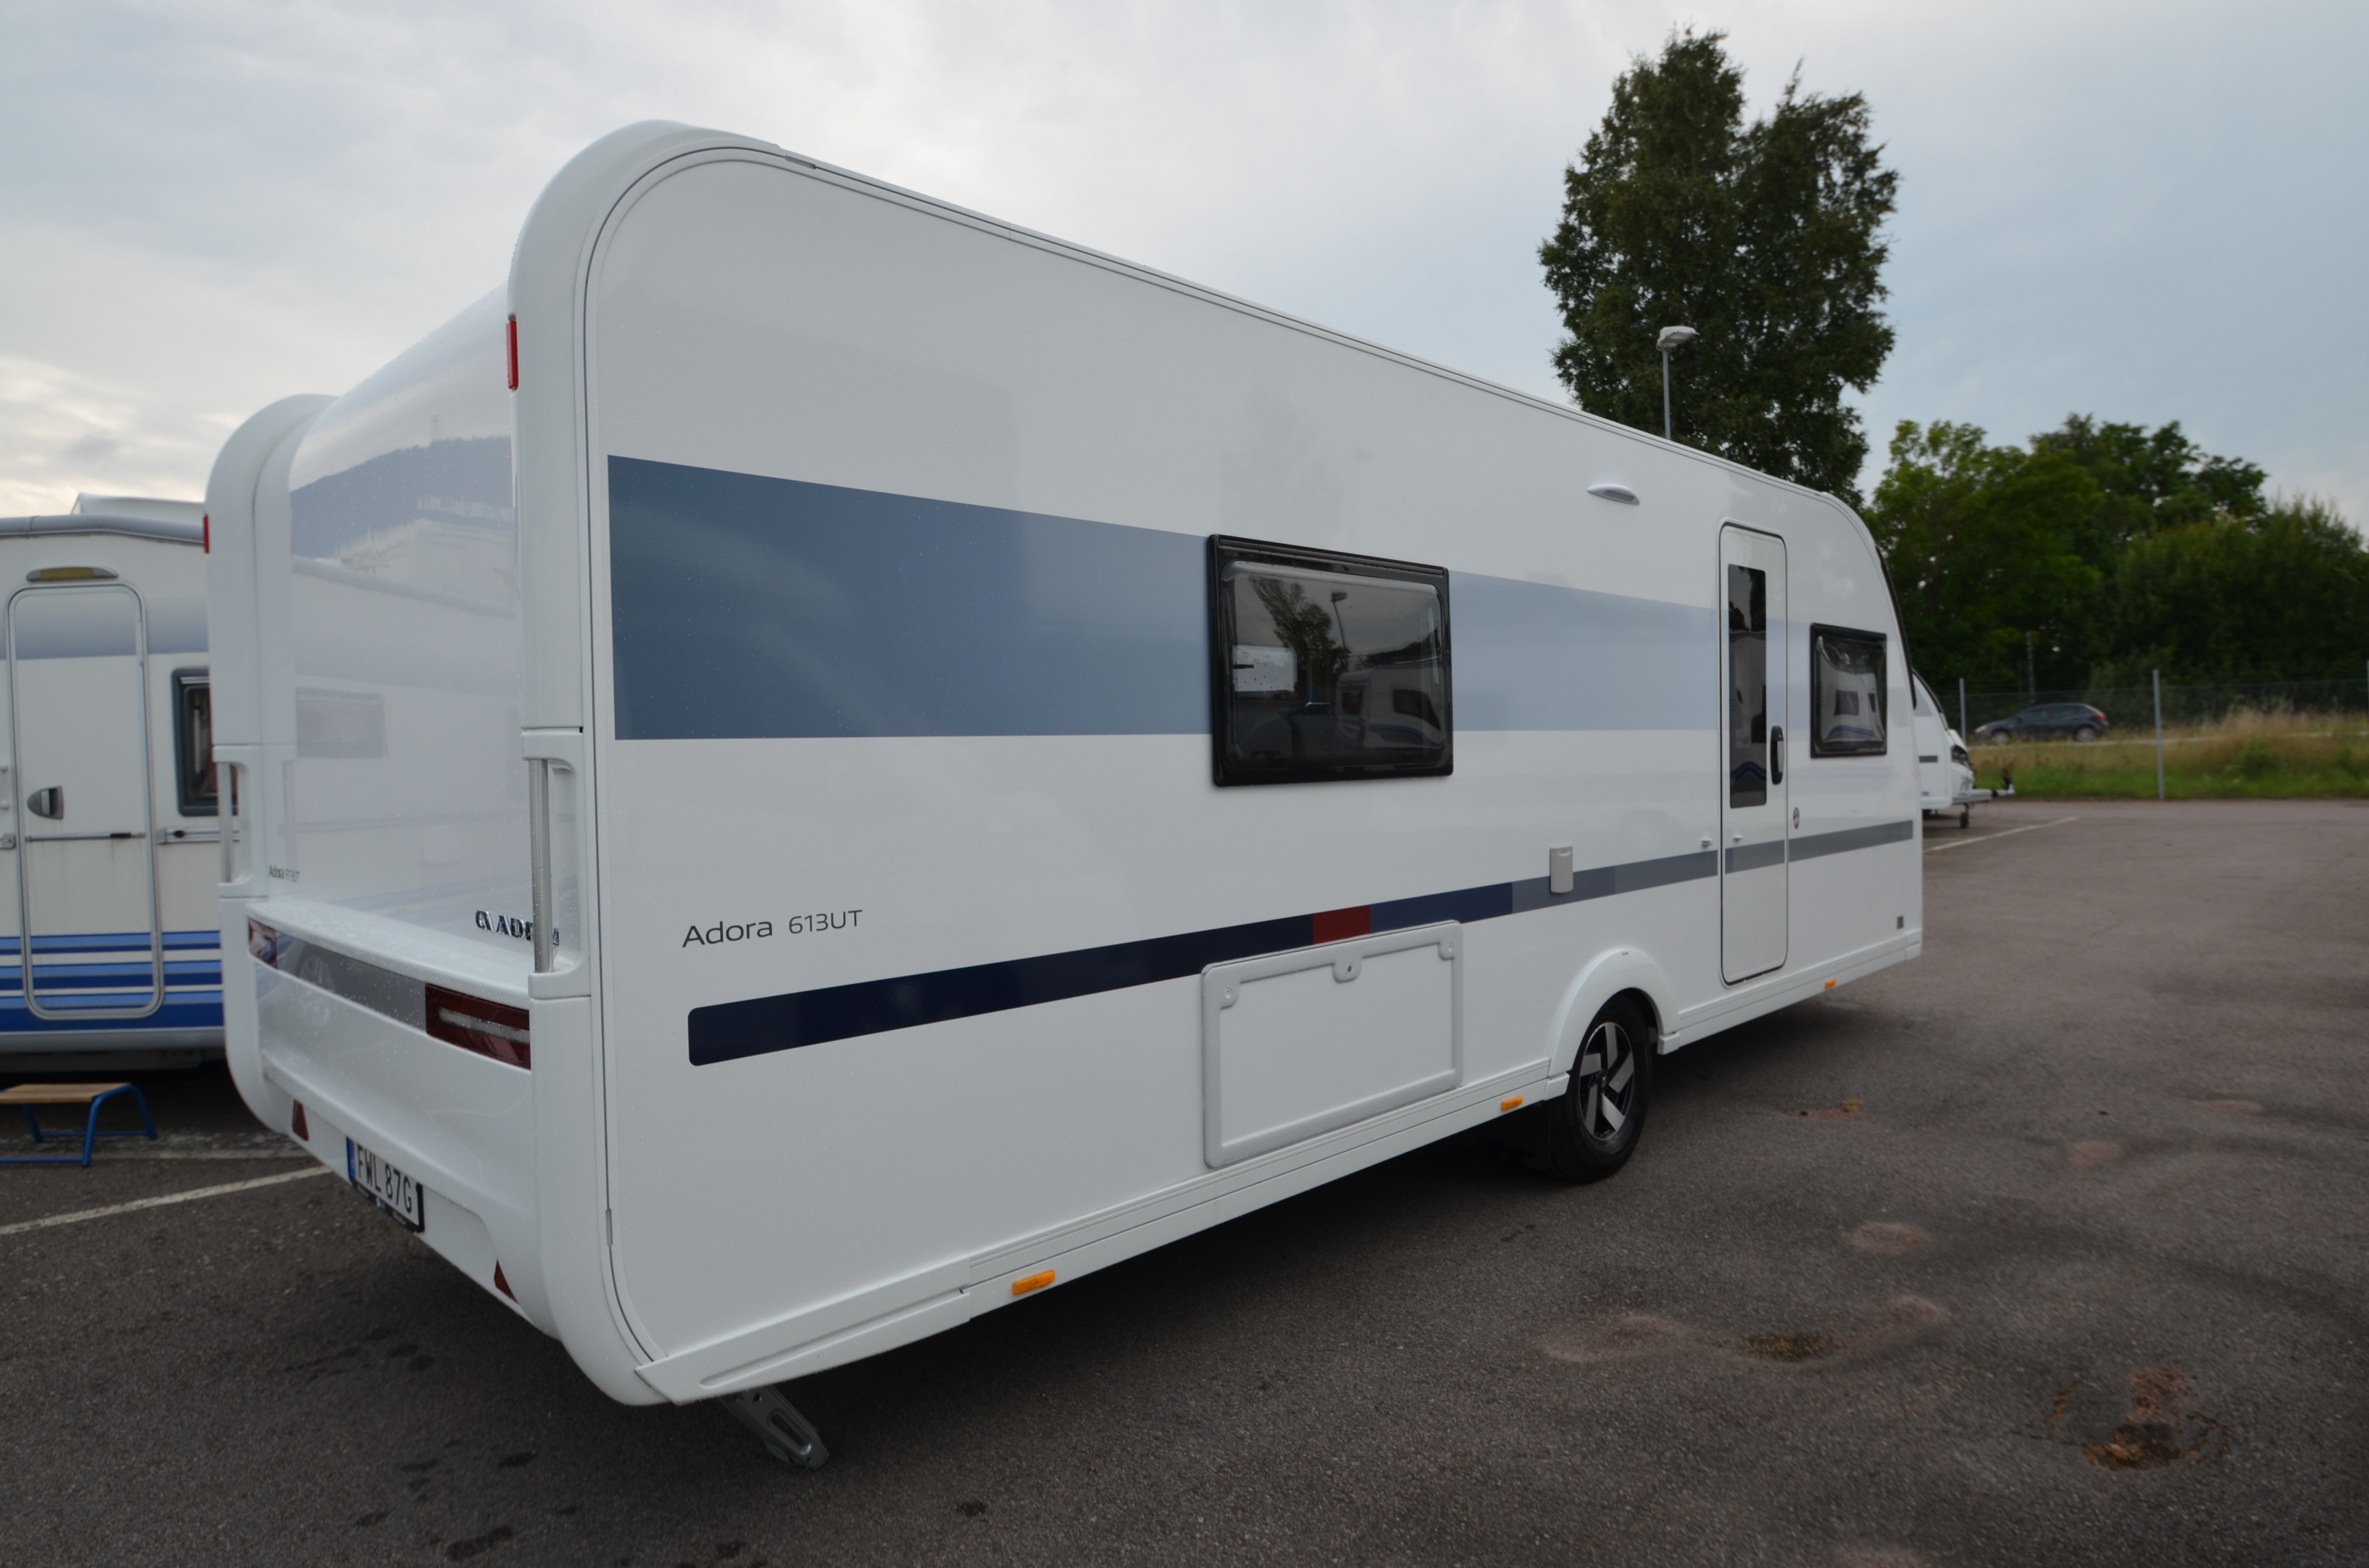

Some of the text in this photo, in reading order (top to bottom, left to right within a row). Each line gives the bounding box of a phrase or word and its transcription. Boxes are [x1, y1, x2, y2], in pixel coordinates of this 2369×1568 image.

[682, 909, 863, 947] Adora 613UT
[358, 1143, 412, 1214] FWL 87G
